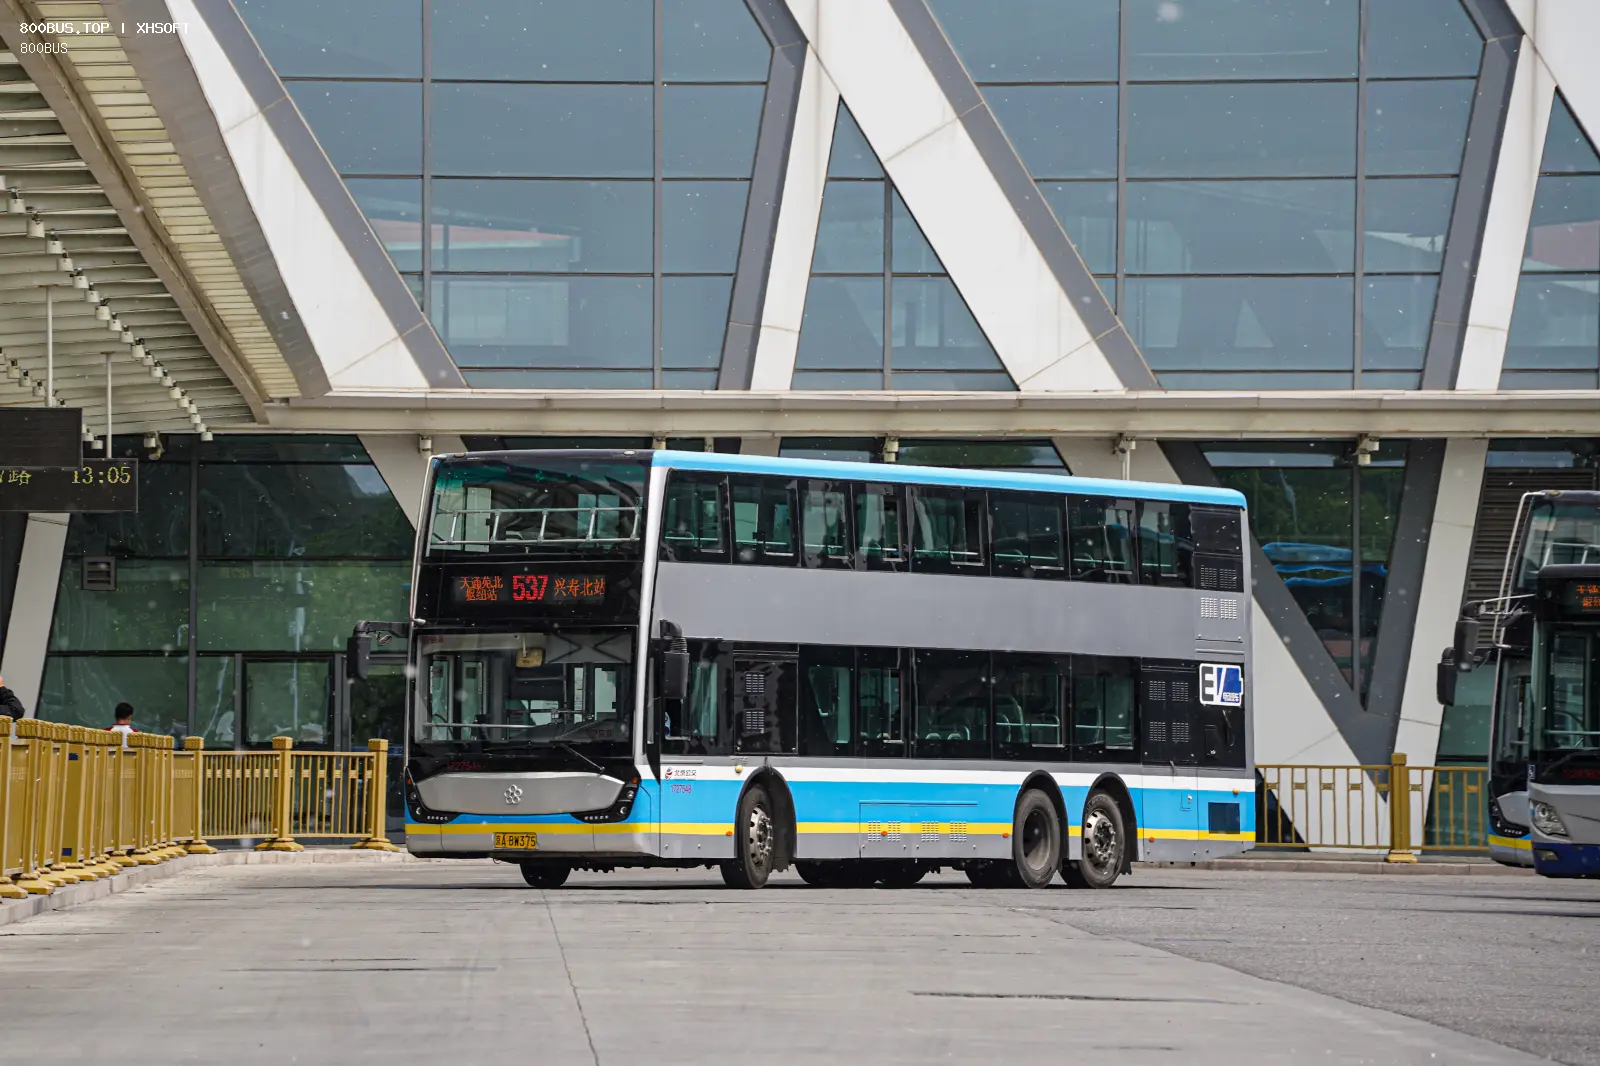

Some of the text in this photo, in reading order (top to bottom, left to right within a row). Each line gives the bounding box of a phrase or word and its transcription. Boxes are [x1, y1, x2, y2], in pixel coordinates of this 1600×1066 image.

[71, 466, 131, 484] 13:05
[460, 575, 504, 589] 天通苑北
[512, 574, 549, 601] 537
[554, 577, 606, 597] 兴寿北站
